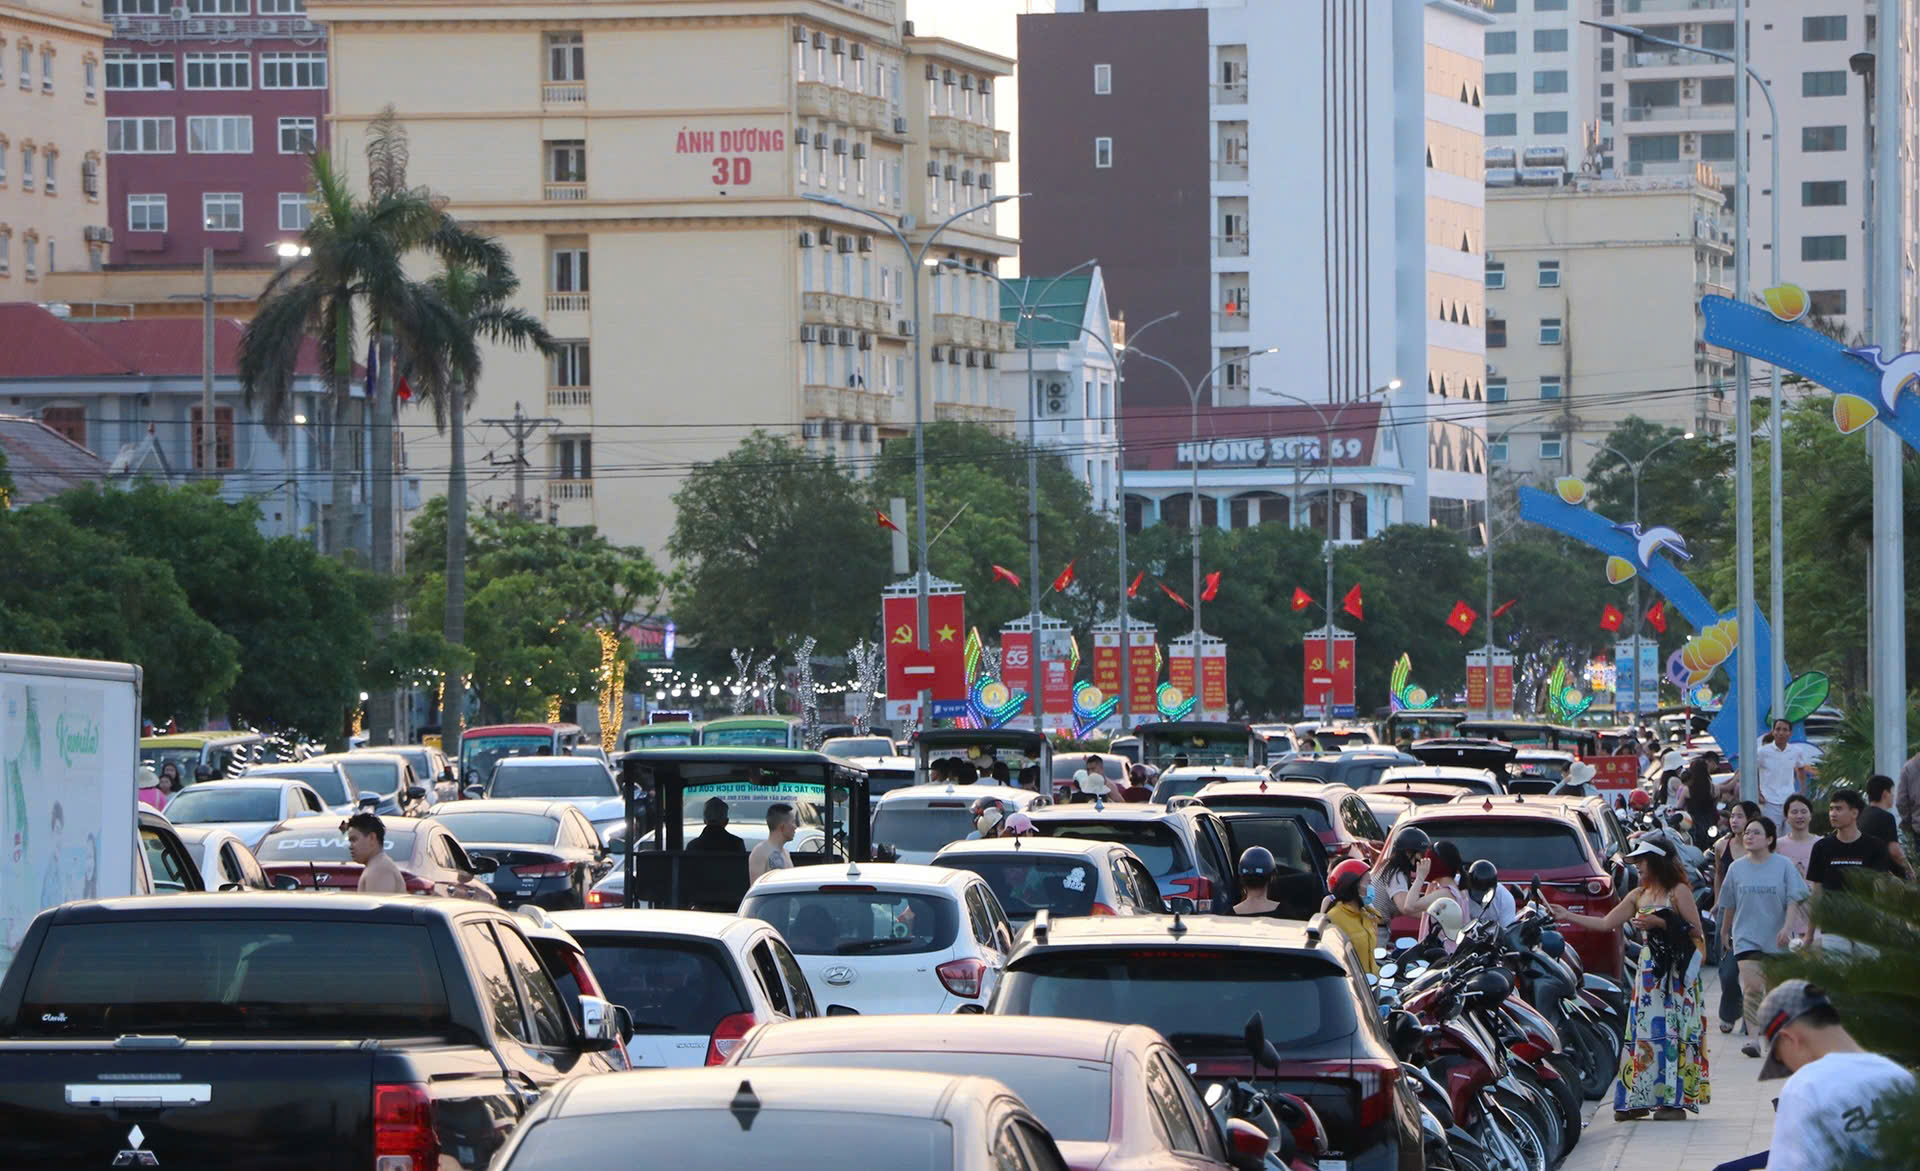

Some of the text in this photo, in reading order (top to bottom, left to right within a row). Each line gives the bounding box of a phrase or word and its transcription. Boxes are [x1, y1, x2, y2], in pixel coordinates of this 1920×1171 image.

[712, 157, 752, 185] 3D
[1331, 437, 1362, 459] 69
[1006, 650, 1029, 665] 5G
